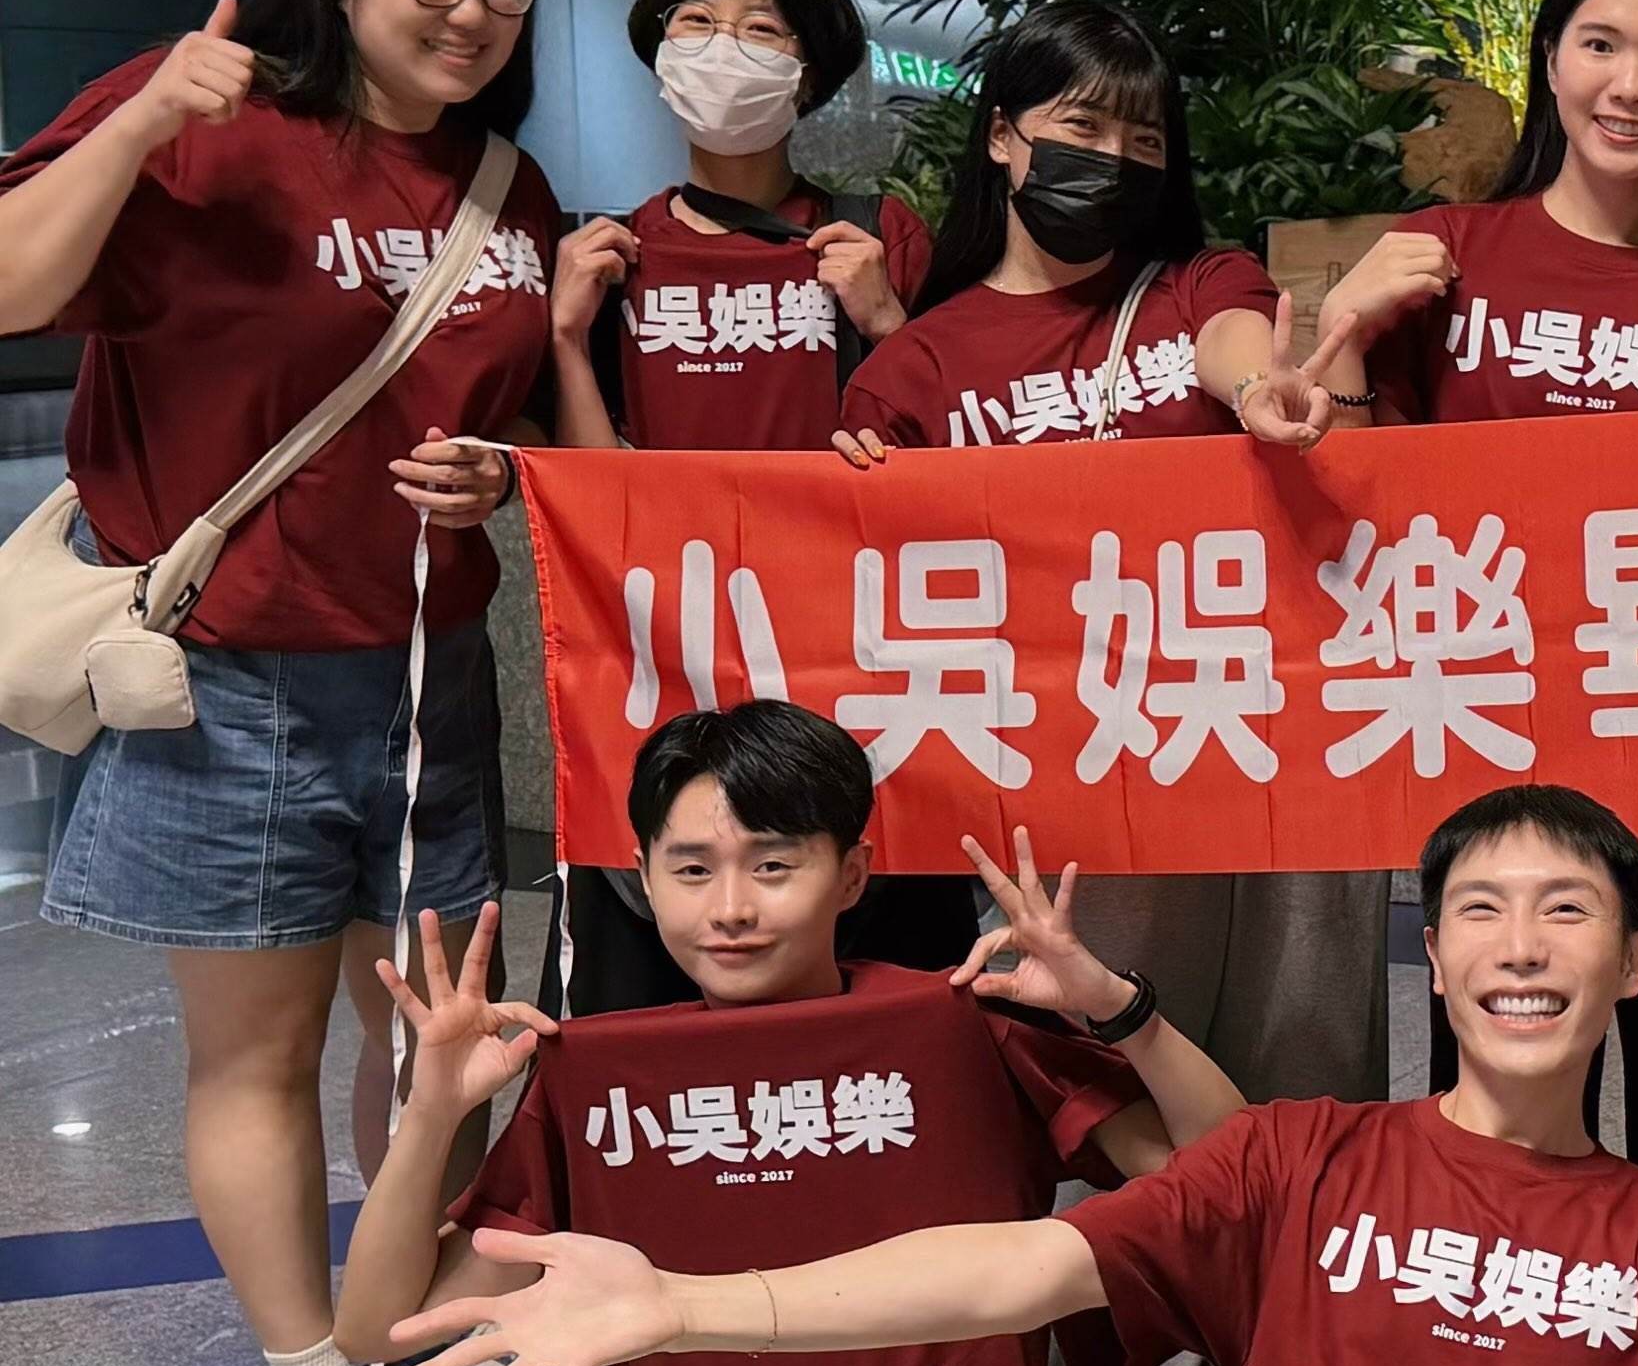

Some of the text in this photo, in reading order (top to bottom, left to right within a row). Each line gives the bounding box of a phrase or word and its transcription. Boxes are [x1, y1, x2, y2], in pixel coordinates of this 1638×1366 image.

[451, 301, 481, 315] 2017
[621, 279, 836, 354] 吳娛樂
[677, 361, 744, 372] since 2017
[1546, 392, 1616, 410] since 2017
[585, 1072, 916, 1166] 小吳娛樂
[715, 1170, 794, 1185] since 2017
[1431, 1323, 1506, 1351] since 2017
